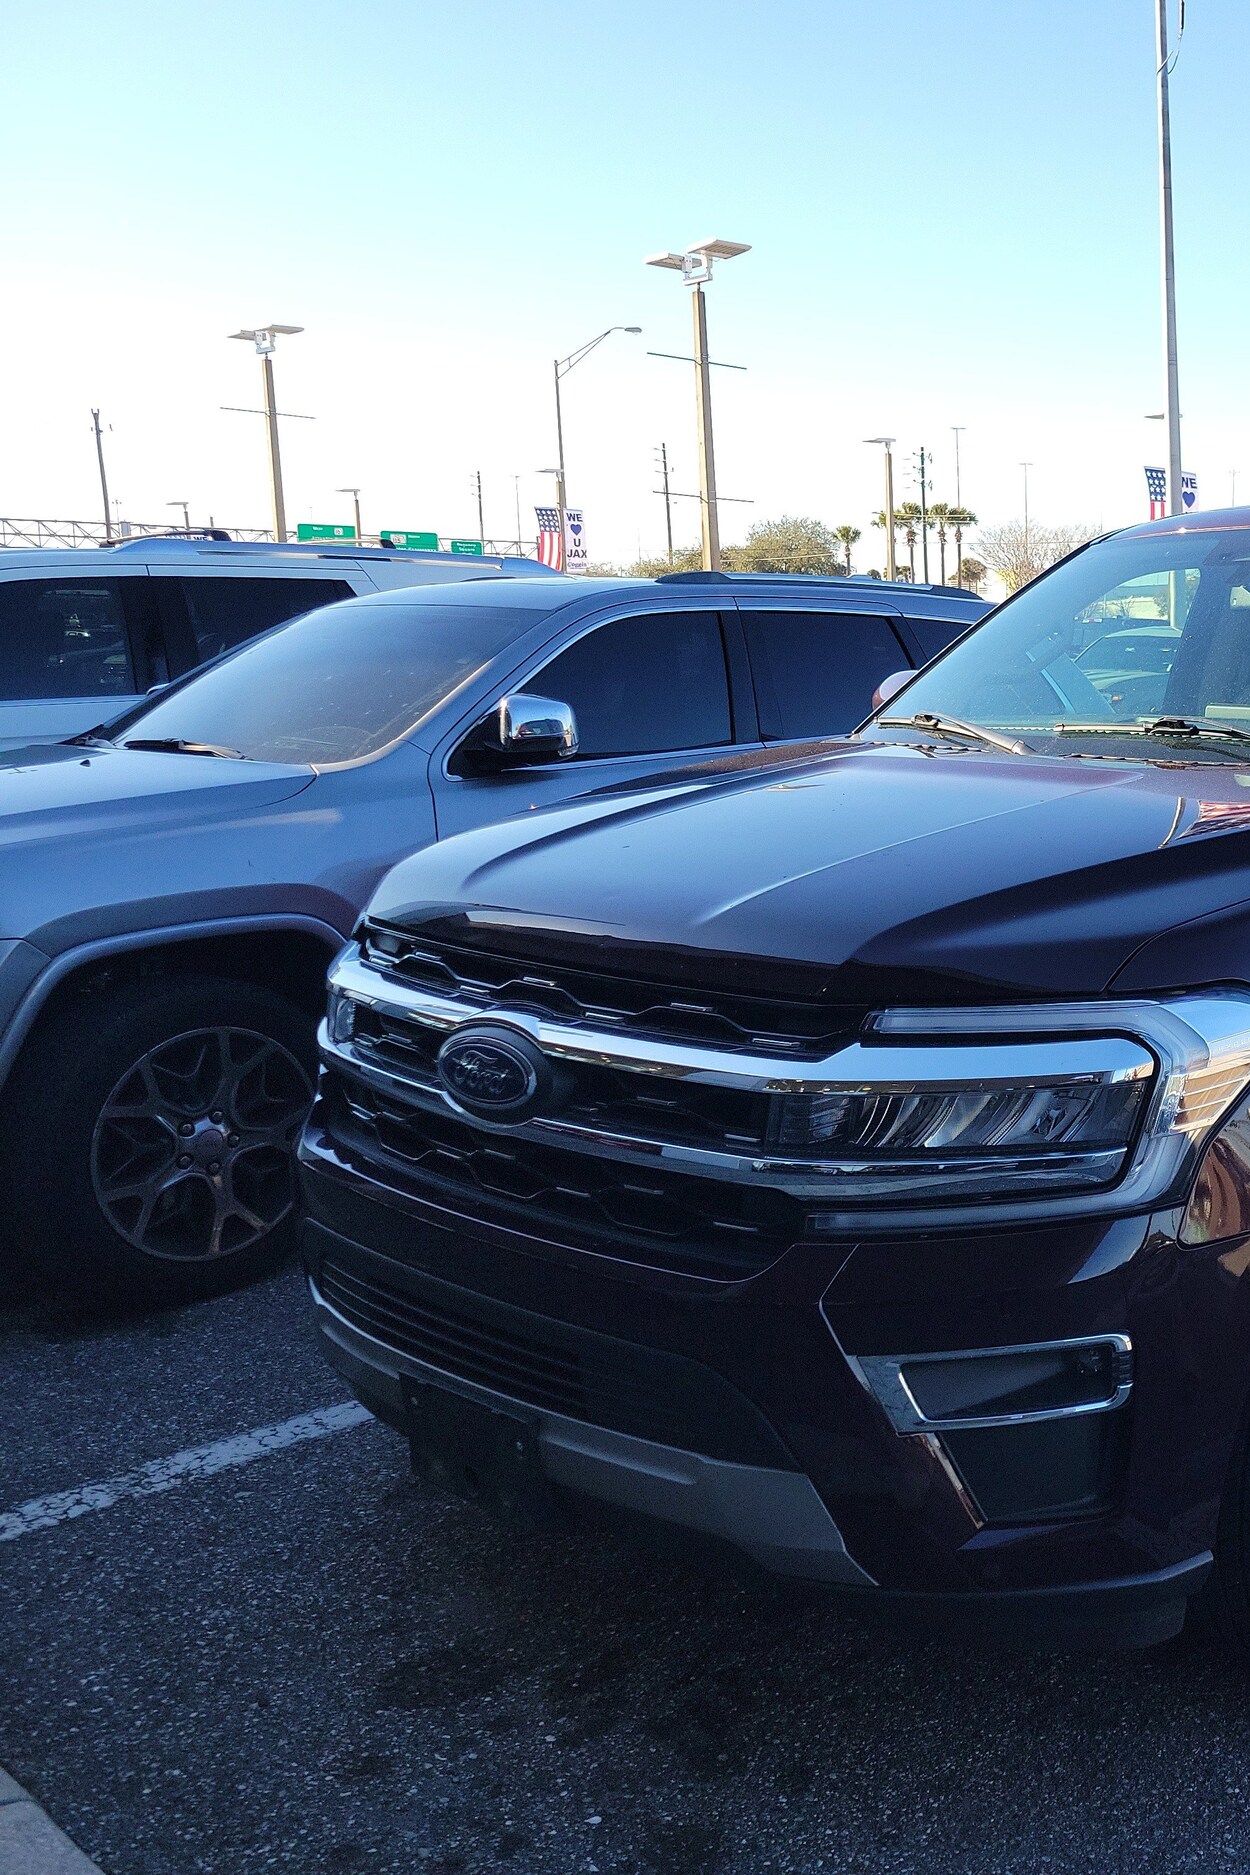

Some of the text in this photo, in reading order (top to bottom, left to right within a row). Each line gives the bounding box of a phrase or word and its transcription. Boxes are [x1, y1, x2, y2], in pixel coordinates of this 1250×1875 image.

[566, 512, 583, 522] WE
[573, 538, 581, 547] U
[567, 549, 587, 558] JAX
[452, 1050, 513, 1095] Ford
